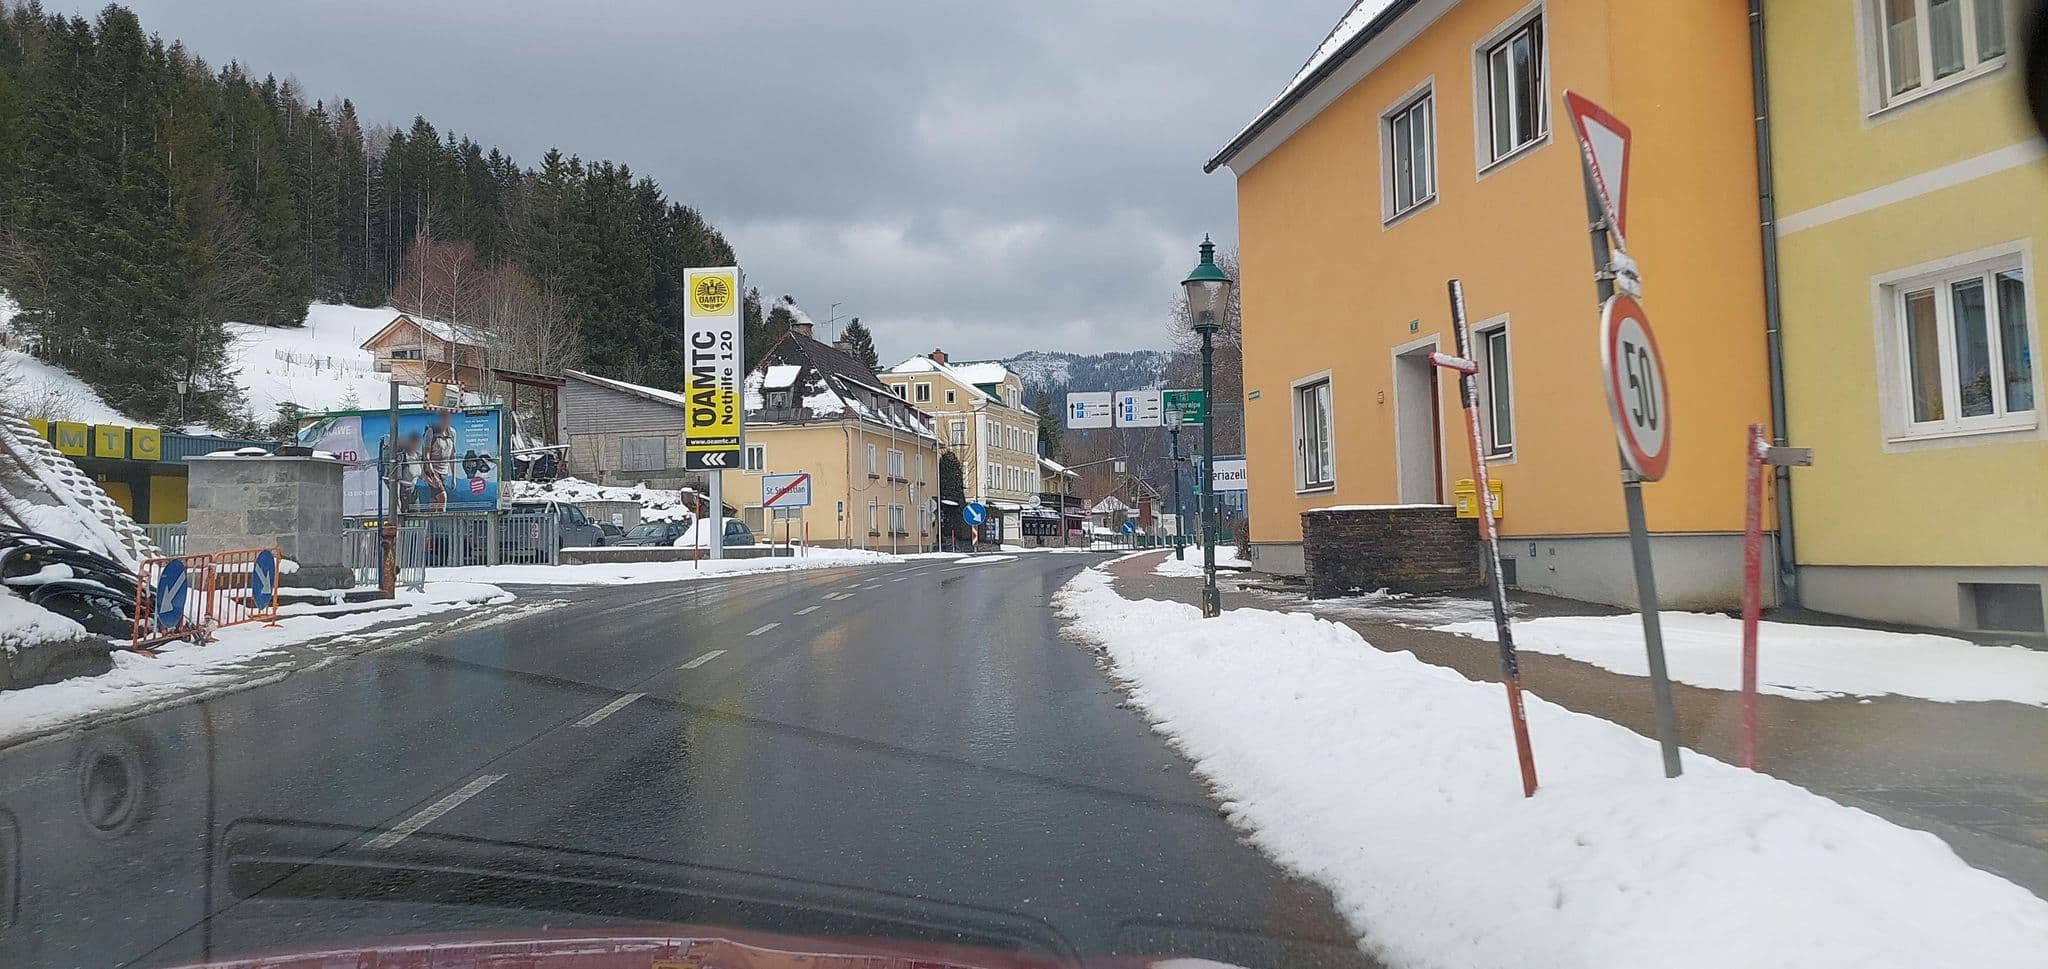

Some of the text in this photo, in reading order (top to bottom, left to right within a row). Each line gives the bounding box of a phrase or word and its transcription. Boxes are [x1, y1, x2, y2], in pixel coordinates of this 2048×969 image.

[692, 331, 717, 428] ÖAMTC
[721, 330, 733, 425] Nothilfe 120
[1623, 341, 1657, 431] 50
